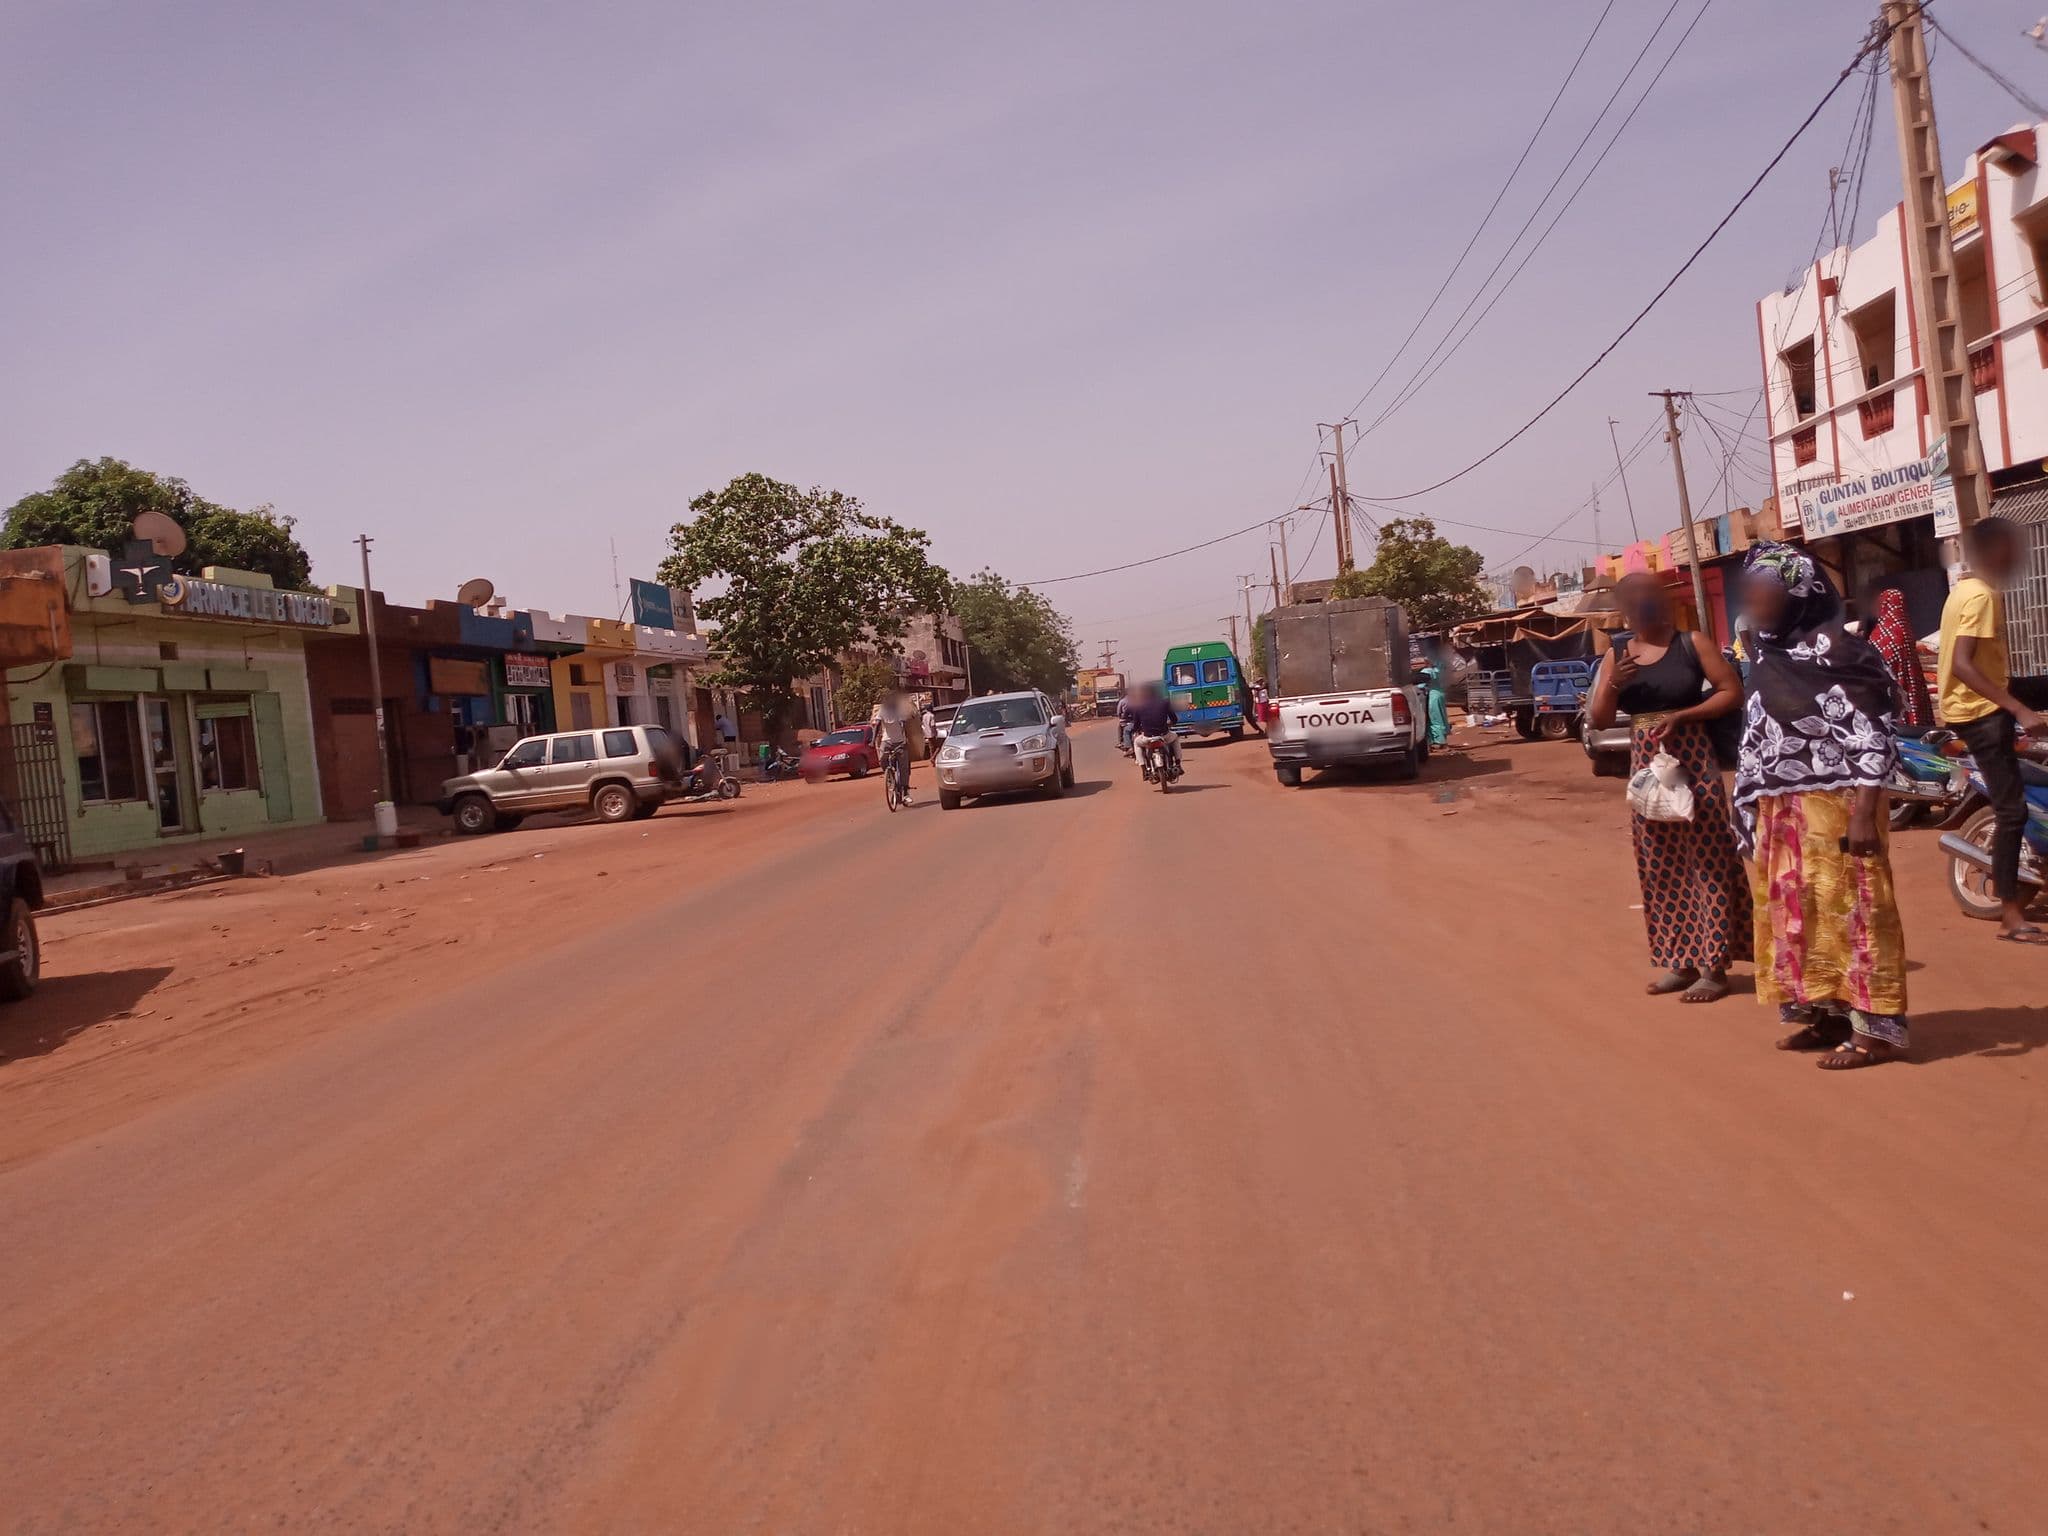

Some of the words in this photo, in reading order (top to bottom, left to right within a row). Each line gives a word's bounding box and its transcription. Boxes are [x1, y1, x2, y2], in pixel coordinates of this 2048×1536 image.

[1819, 479, 1867, 505] GUINTAN
[1837, 491, 1897, 518] ALIMENTATION
[175, 579, 249, 618] HARMACIE
[1296, 710, 1375, 729] TOYOTA
